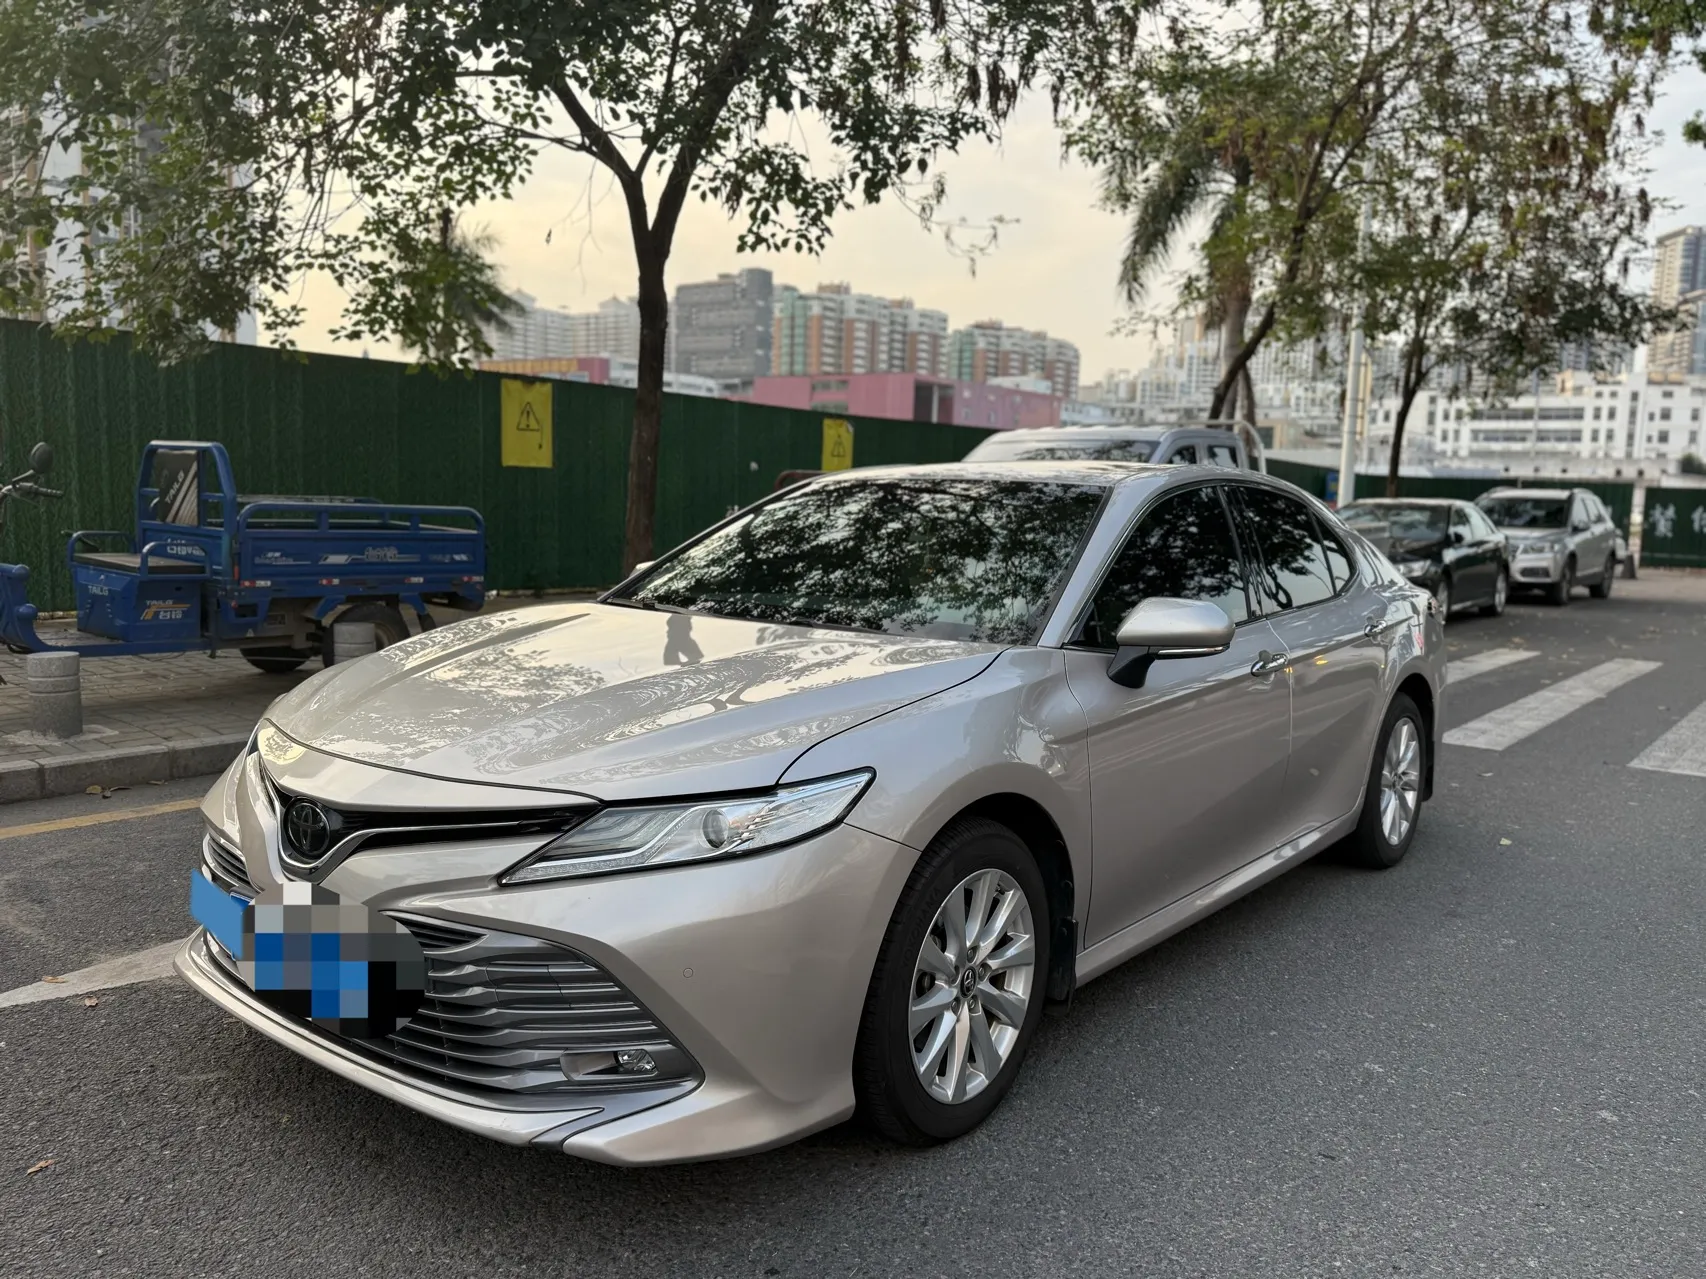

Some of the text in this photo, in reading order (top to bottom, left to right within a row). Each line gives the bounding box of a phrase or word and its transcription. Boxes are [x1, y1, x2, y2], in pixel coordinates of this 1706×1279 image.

[164, 469, 185, 504] TAILG
[88, 585, 109, 596] TAILG
[900, 886, 941, 969] YOKOHAMA
